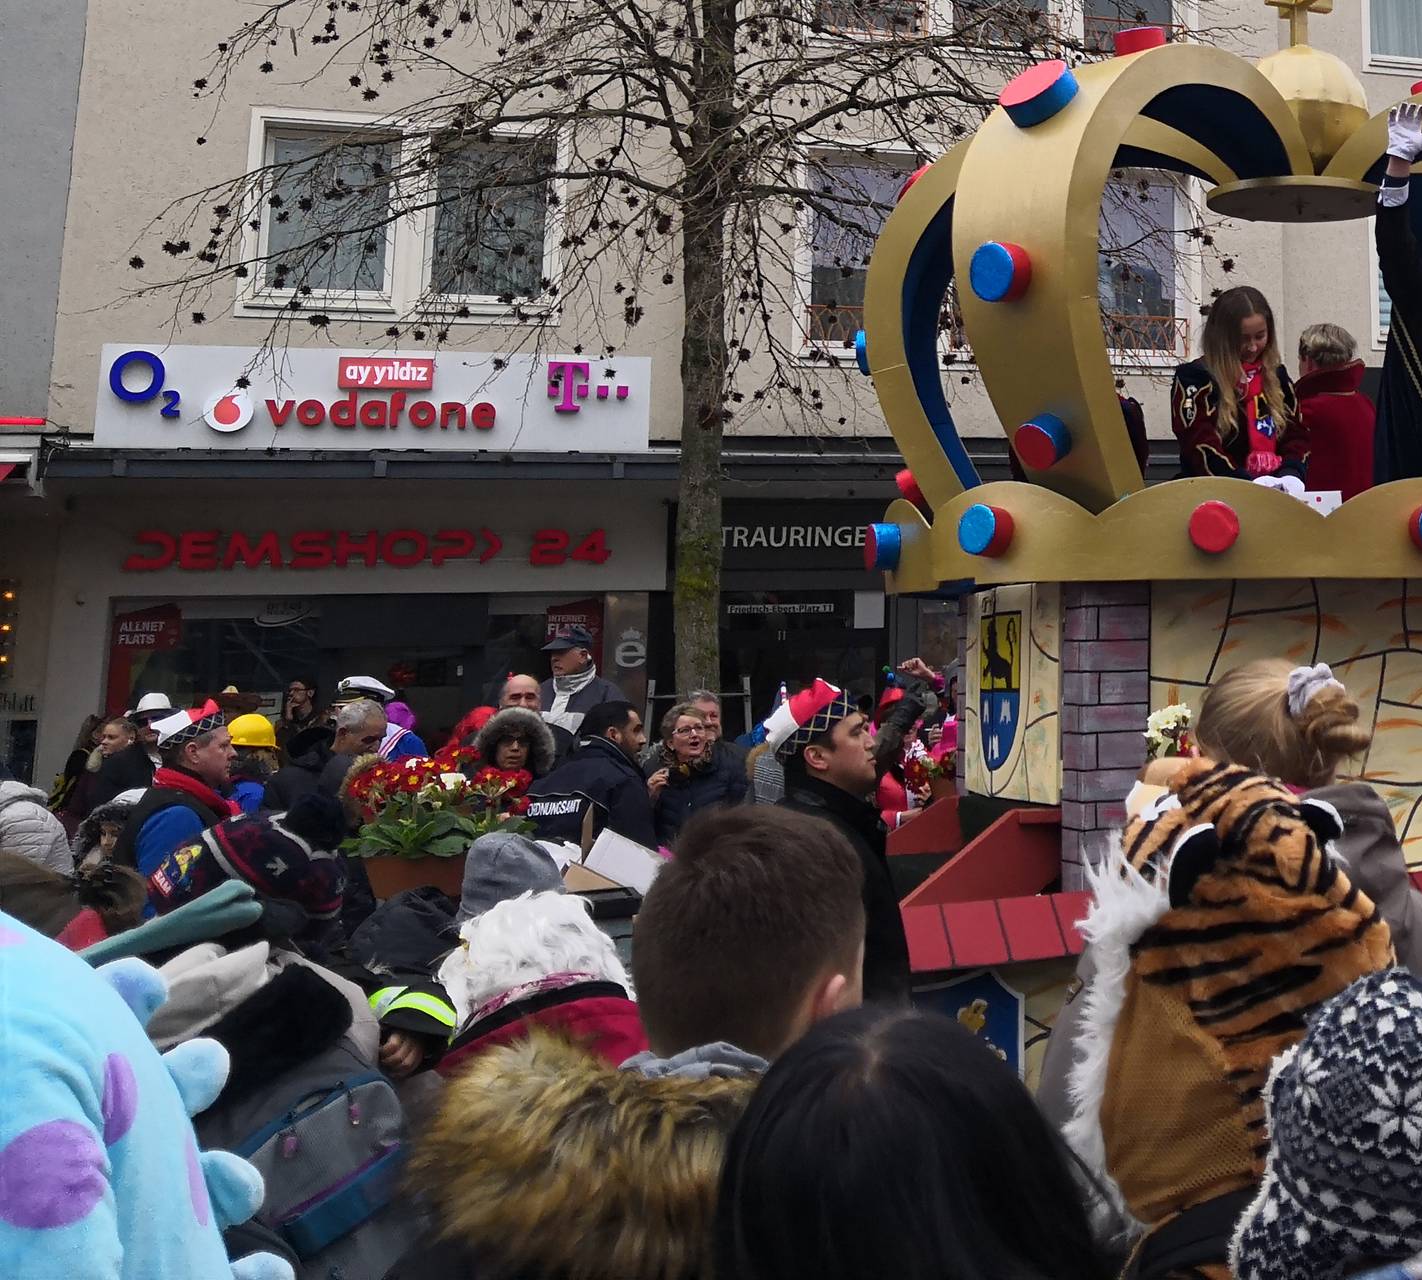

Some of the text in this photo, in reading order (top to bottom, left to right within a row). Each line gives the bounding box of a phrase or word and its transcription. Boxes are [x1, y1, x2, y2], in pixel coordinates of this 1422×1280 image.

[345, 364, 370, 385] ay
[265, 391, 497, 429] vodafone
[529, 528, 612, 567] 24
[721, 526, 866, 548] TRAURINGE
[119, 621, 166, 632] ALLNET
[548, 614, 587, 624] INTERNET
[118, 633, 156, 645] FLATS
